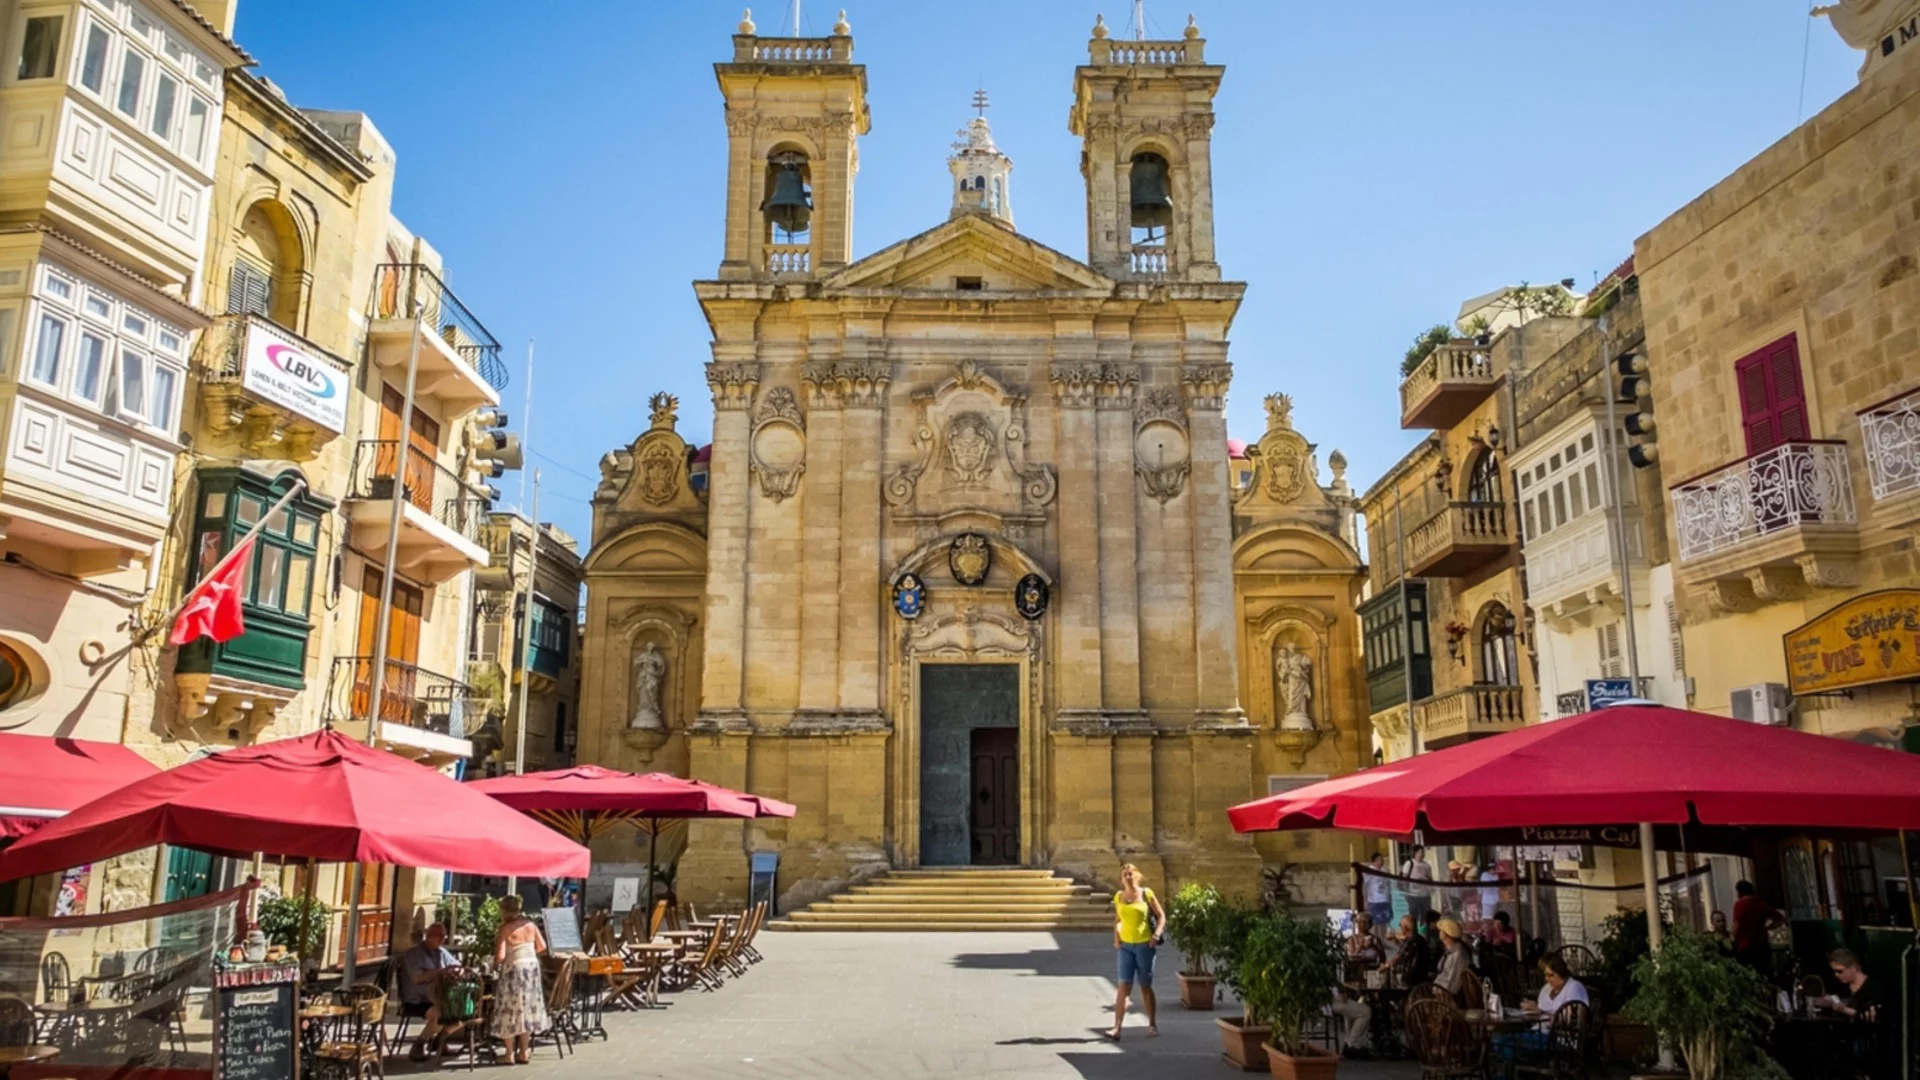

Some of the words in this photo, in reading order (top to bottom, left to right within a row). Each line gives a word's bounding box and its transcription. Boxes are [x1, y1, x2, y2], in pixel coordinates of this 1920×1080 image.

[285, 356, 320, 384] LBV
[1522, 826, 1593, 841] Piazza
[1600, 826, 1640, 846] Caf
